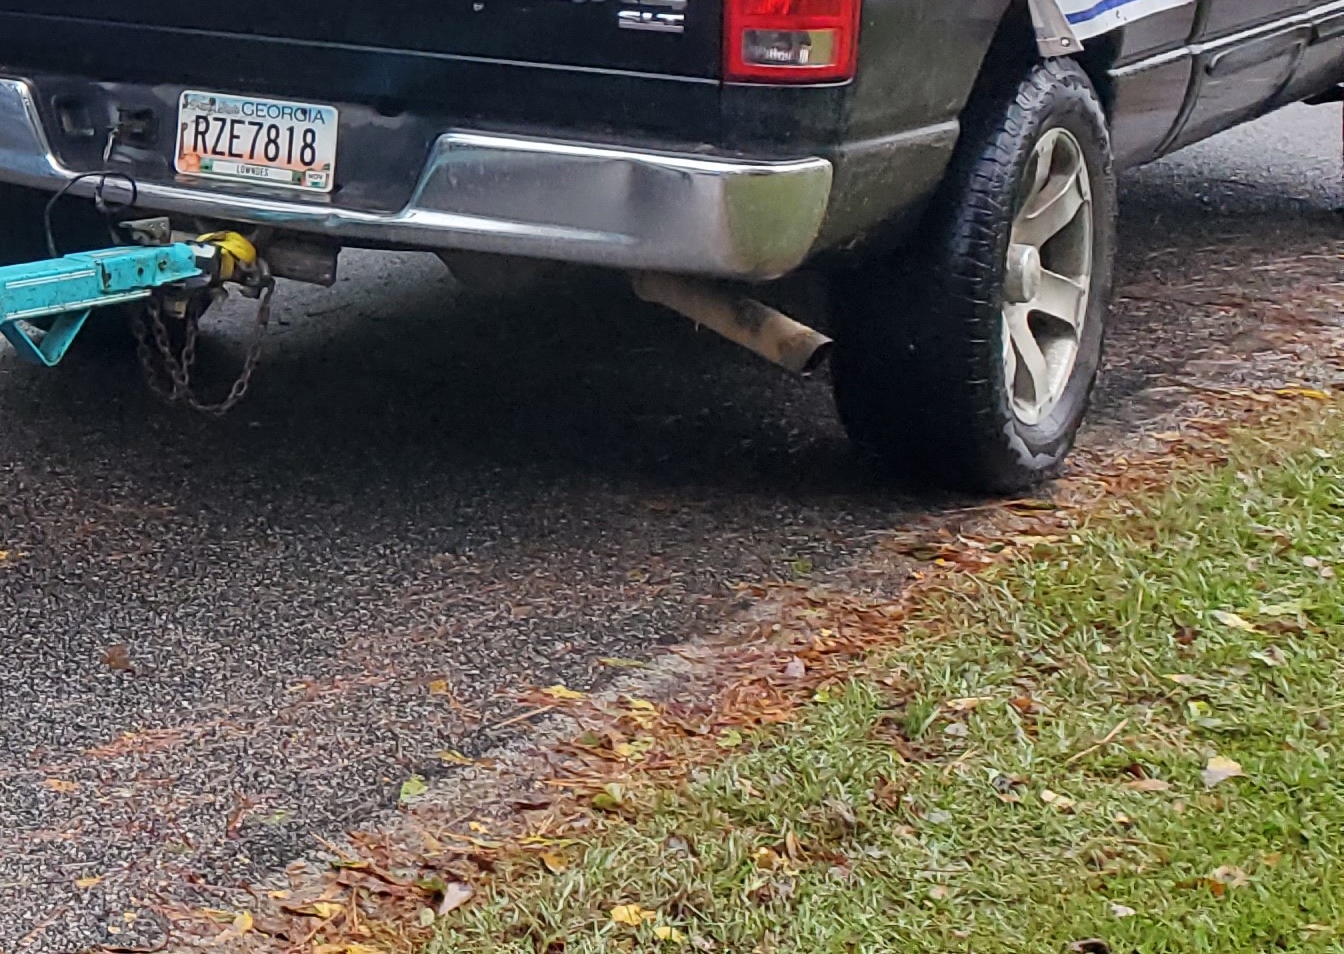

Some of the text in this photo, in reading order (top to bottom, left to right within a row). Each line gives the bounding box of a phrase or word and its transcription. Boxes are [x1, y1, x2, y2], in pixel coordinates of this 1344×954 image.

[241, 101, 325, 125] GEORGIA
[193, 114, 316, 167] RZE7818
[236, 164, 269, 177] LOWNDES
